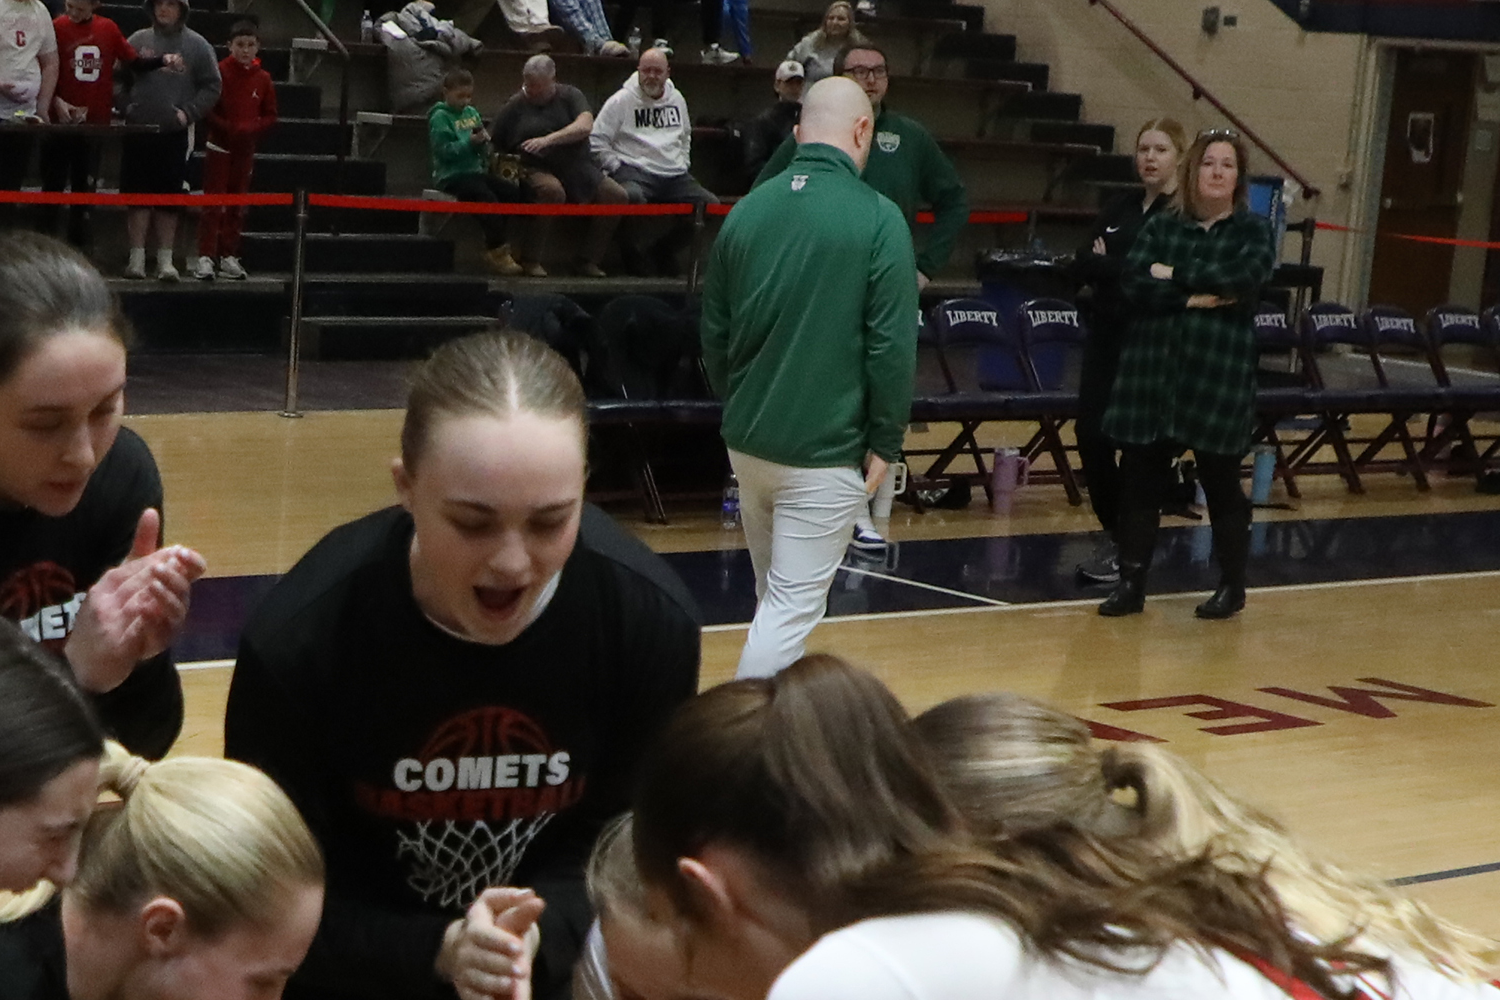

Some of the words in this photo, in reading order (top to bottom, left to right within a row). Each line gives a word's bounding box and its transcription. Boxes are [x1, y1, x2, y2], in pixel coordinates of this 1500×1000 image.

[15, 30, 26, 47] C
[634, 105, 681, 128] MARVEL
[946, 310, 998, 328] LIBERTY
[1027, 310, 1079, 328] LIBERTY
[1312, 313, 1357, 331] LIBERTY
[1374, 316, 1416, 333] LIBERTY
[1438, 313, 1480, 329] LIBERTY
[393, 751, 571, 793] COMETS
